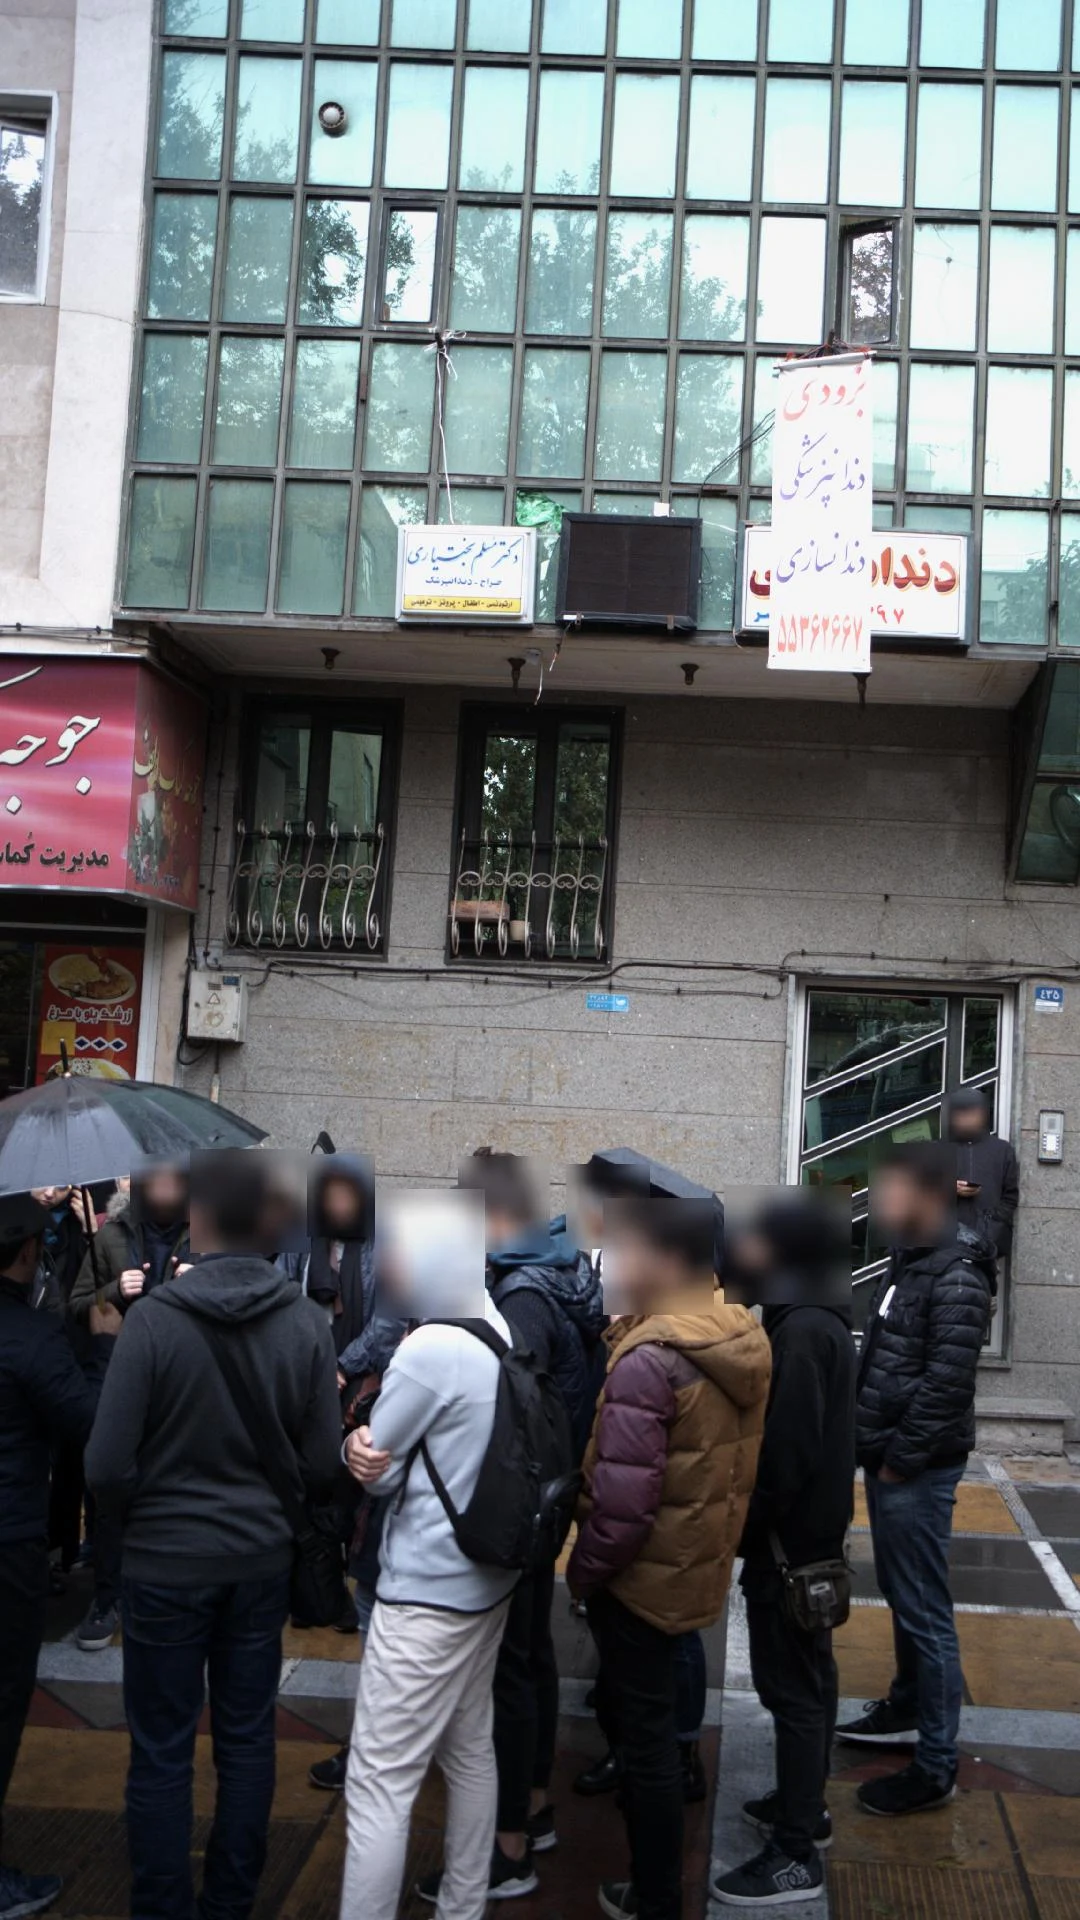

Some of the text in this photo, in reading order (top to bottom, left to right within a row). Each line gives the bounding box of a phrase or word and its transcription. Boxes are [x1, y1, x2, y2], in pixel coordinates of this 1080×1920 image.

[407, 537, 476, 571] بختیاری
[490, 537, 522, 569] دکتر
[40, 847, 109, 873] مدیریت
[100, 1005, 133, 1025] زرشک
